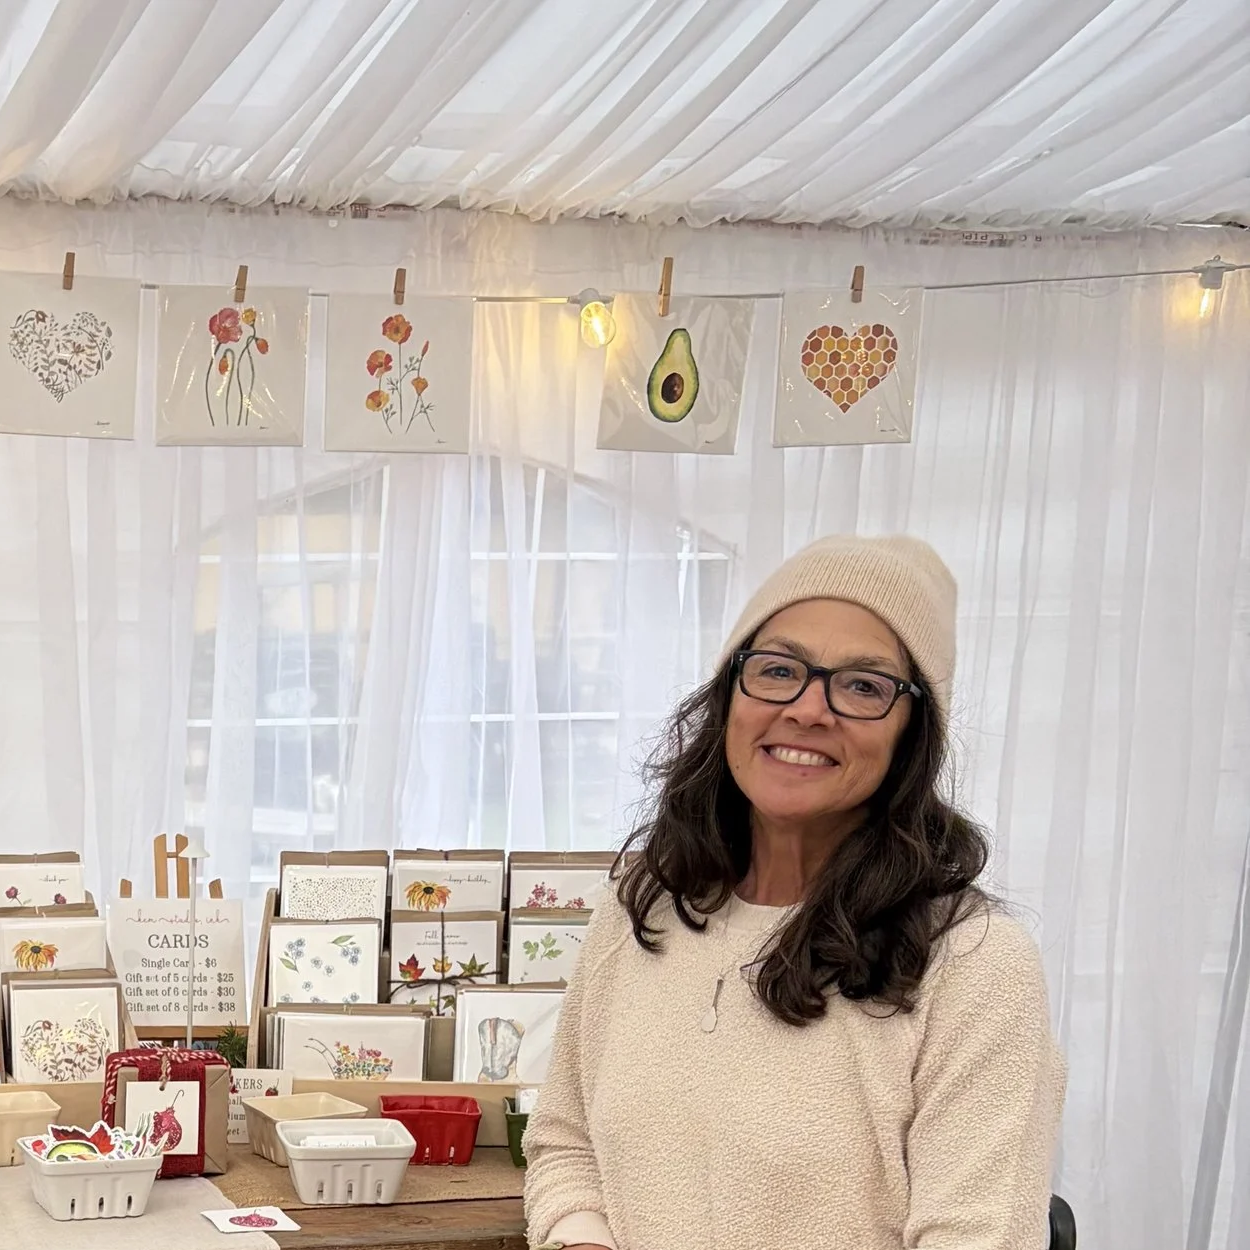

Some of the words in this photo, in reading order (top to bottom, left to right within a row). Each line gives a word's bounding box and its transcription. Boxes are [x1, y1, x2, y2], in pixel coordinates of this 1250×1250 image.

[141, 958, 170, 970] Single
[173, 958, 195, 967] Car
[205, 957, 217, 968] $6
[125, 973, 143, 982] Gift
[161, 973, 171, 982] of
[173, 973, 179, 982] 5
[181, 973, 207, 982] crds
[217, 972, 234, 983] $25
[125, 987, 143, 997] Gift
[146, 988, 158, 997] set
[161, 987, 171, 997] of
[173, 987, 179, 997] 6
[181, 987, 207, 997] crds
[217, 986, 235, 997] $30
[126, 1003, 143, 1012] Gift
[146, 1004, 159, 1012] set
[162, 1003, 172, 1012] of
[174, 1003, 180, 1012] 8
[182, 1003, 208, 1012] crds
[218, 1002, 235, 1012] $38
[235, 1078, 263, 1090] KERS
